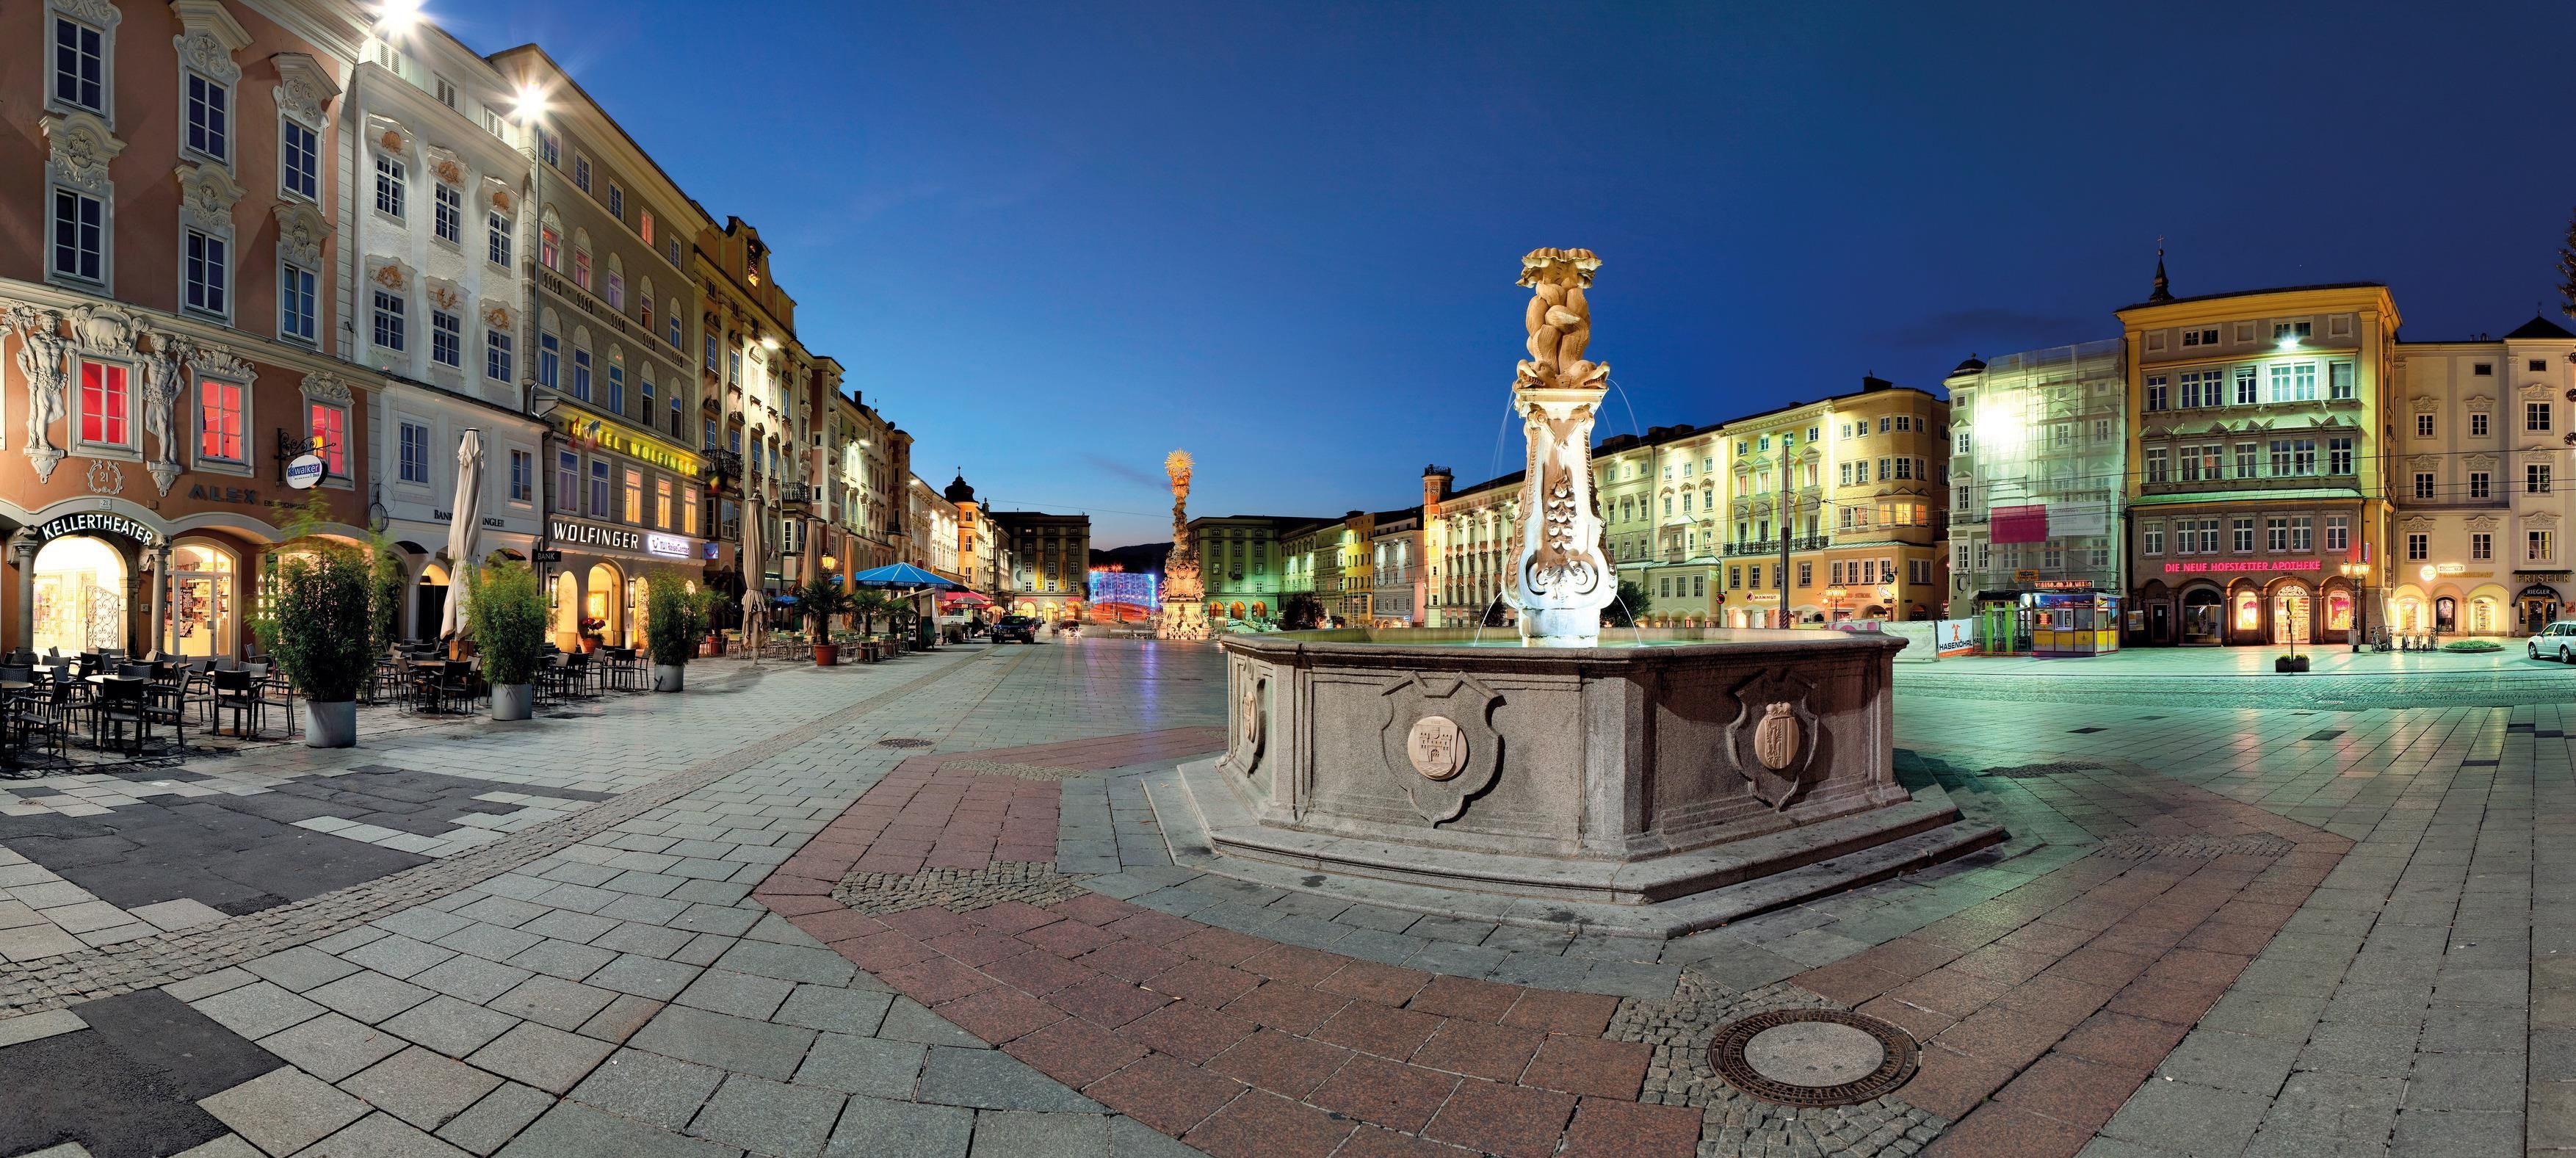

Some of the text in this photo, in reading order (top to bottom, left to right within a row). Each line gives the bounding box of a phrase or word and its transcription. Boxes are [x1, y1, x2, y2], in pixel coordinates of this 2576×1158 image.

[631, 442, 698, 476] WOLFINGER
[100, 471, 109, 482] 21
[294, 465, 319, 475] walker
[188, 484, 256, 504] ALEX
[42, 514, 153, 546] KELLERTHEATER
[554, 522, 639, 549] WOLFINGER
[2166, 563, 2180, 572] DIE
[2183, 562, 2207, 572] NEUE
[2272, 560, 2321, 571] APOTHEKE
[2517, 573, 2569, 583] FRISEUR
[908, 614, 916, 642] EIS
[1939, 640, 1973, 651] HASENÖHRL
